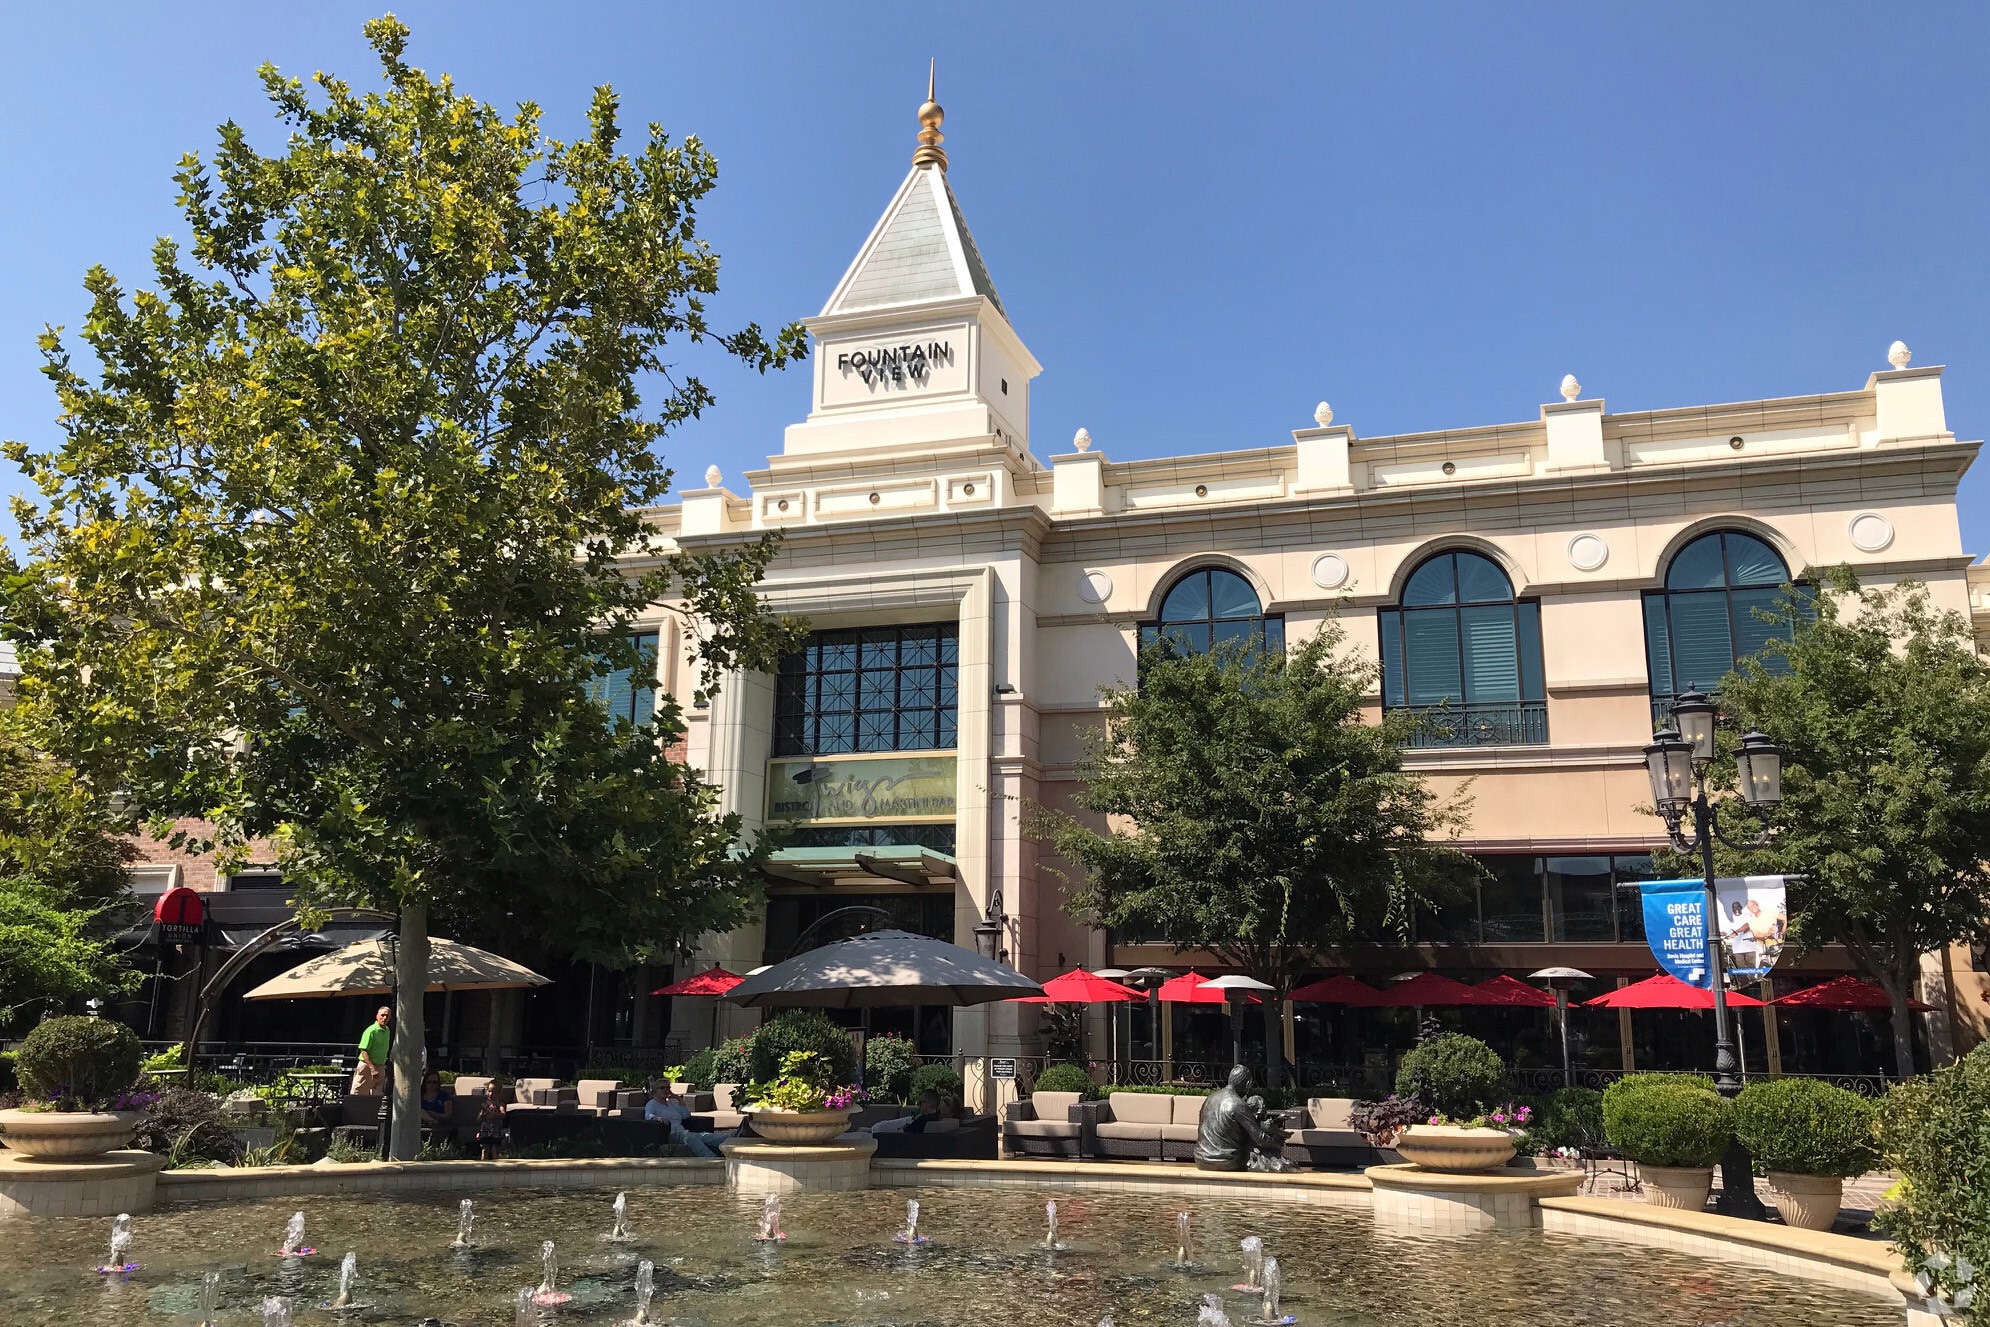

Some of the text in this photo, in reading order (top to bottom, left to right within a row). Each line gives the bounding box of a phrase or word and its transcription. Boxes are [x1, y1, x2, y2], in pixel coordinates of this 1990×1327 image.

[838, 341, 949, 370] FOUNTAIN
[861, 363, 925, 384] VIEW
[774, 801, 812, 813] BISTRO
[829, 799, 854, 811] AND
[880, 797, 928, 809] MARTINI
[1667, 903, 1702, 915] GREAT
[1673, 915, 1702, 926] CARE
[163, 925, 199, 933] TORTILLA
[1669, 927, 1703, 938] GREAT
[1663, 939, 1704, 950] HEALTH
